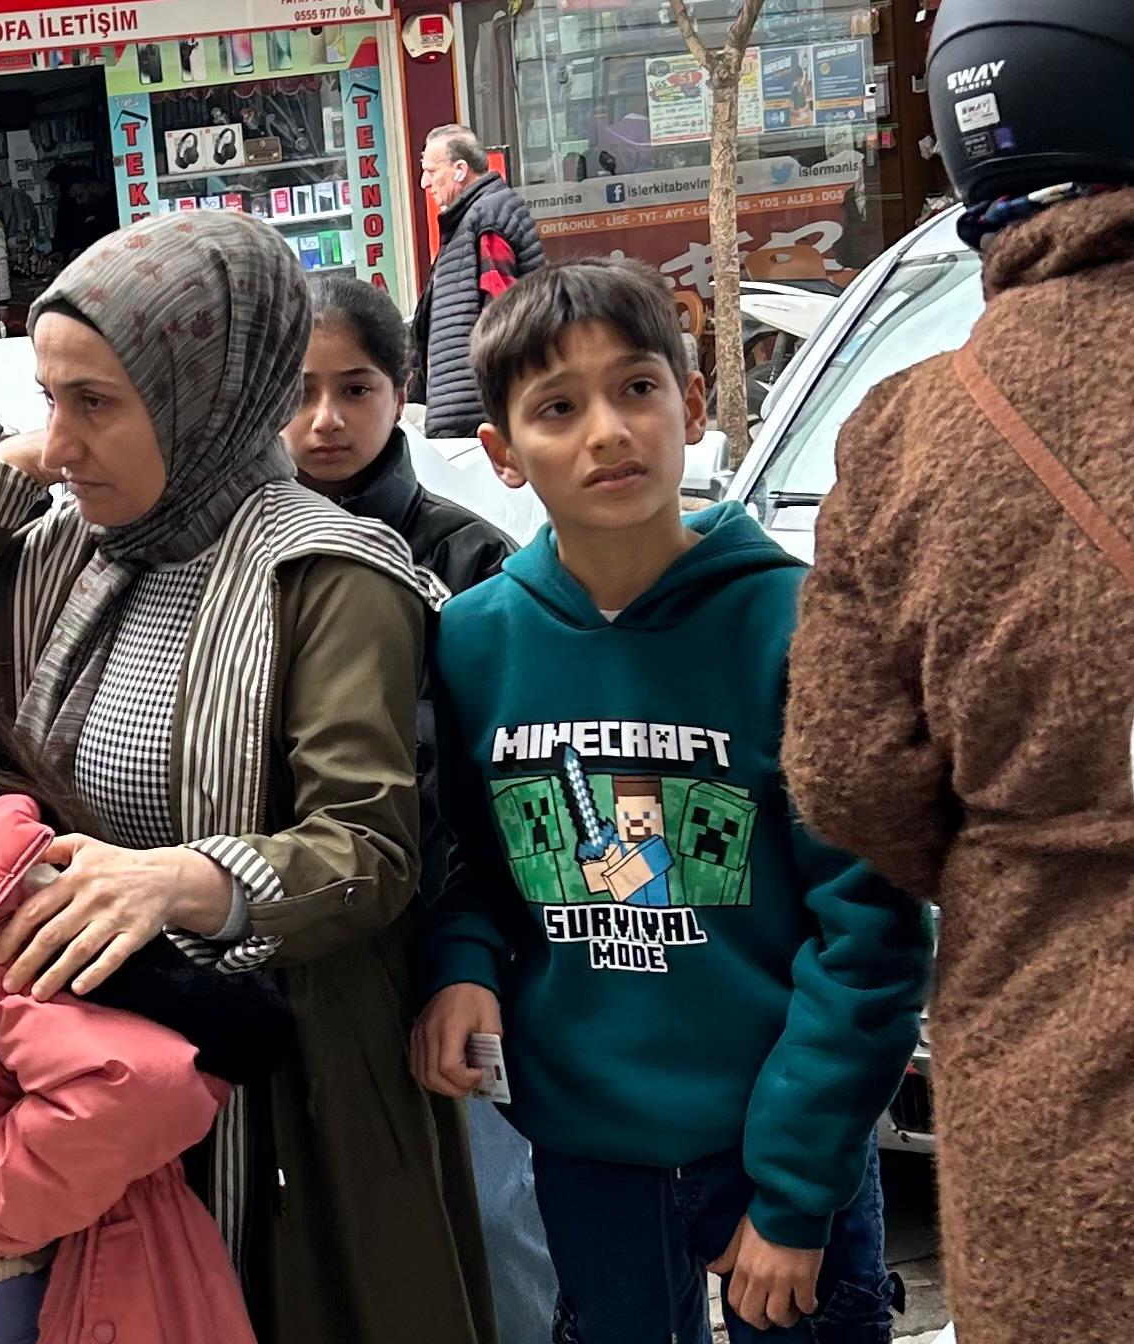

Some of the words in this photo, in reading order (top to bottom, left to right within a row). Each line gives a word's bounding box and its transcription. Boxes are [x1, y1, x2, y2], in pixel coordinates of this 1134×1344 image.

[38, 5, 139, 39] İLETİŞİM
[294, 8, 318, 21] 0555
[320, 7, 337, 19] 977
[339, 6, 352, 17] 00
[947, 60, 1005, 90] SWAY
[352, 95, 389, 293] TEKNOFA
[540, 220, 599, 234] ORTAOKUL
[606, 214, 629, 227] LİSE
[638, 211, 657, 222] TYT
[665, 208, 685, 219] AYT
[759, 197, 779, 208] YDS
[787, 194, 813, 205] ALES
[821, 190, 844, 201] DGS
[492, 720, 731, 768] MINECRAFT
[543, 905, 708, 945] SURVIVAL
[589, 939, 668, 972] MODE
